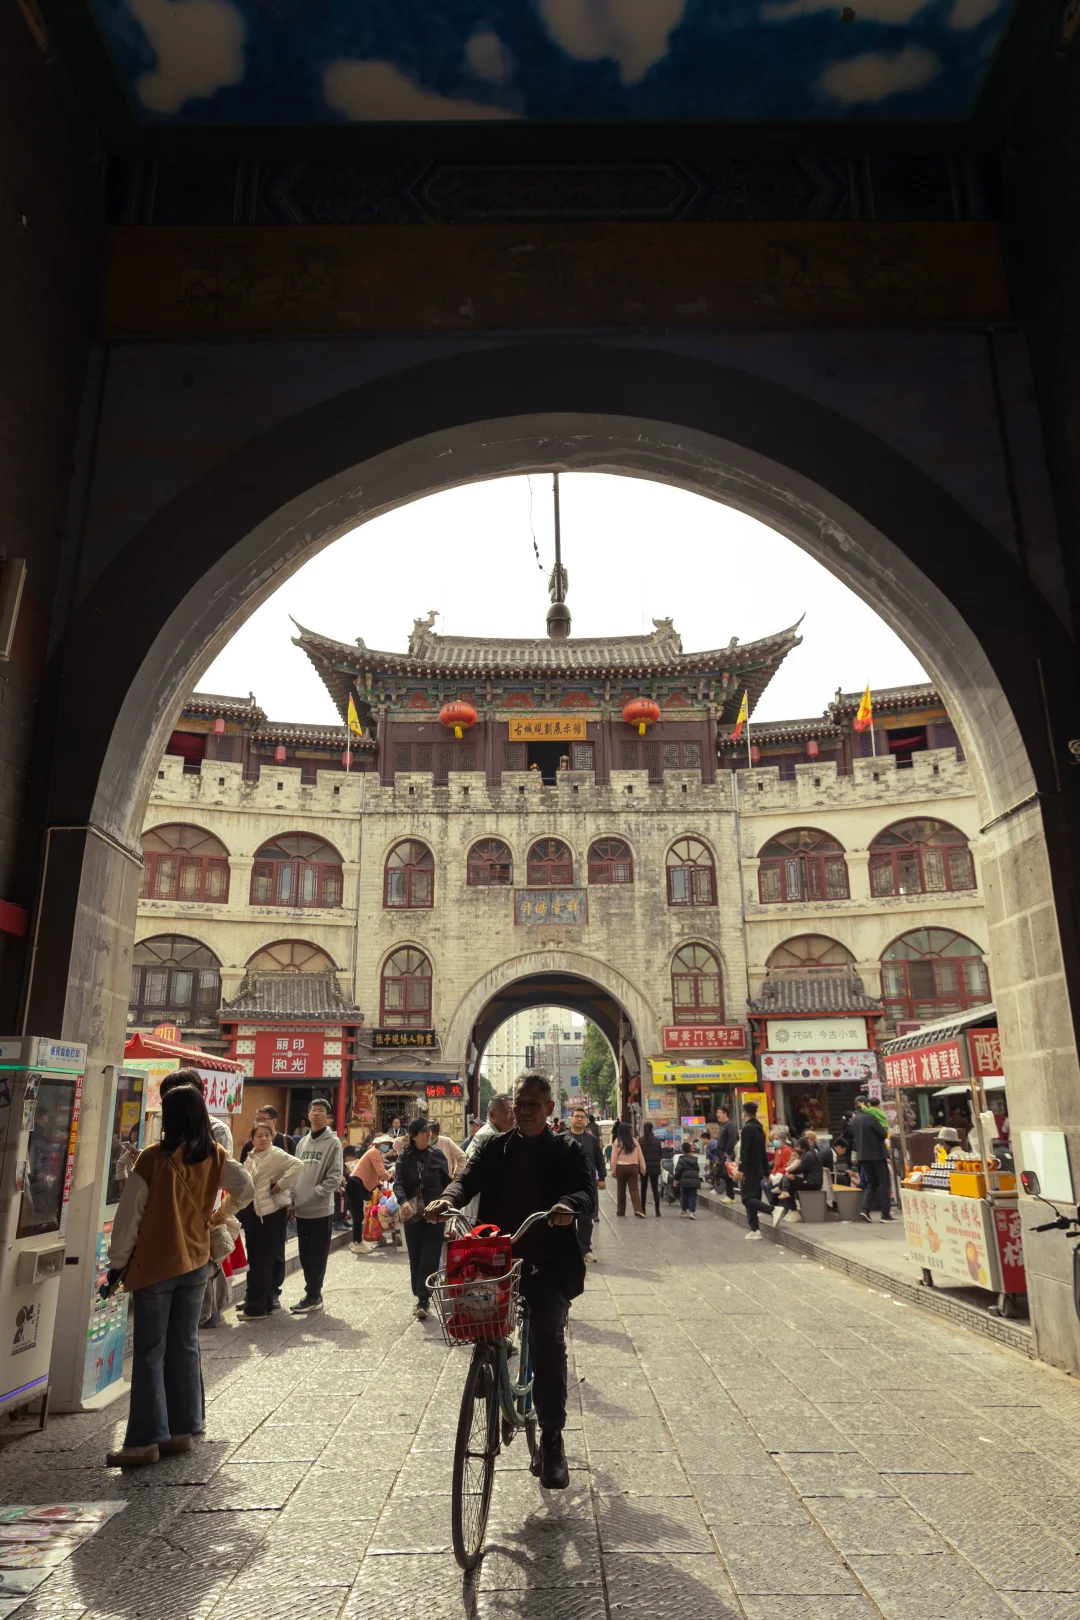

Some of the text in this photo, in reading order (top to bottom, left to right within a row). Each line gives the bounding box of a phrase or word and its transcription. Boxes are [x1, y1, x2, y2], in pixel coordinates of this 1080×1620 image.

[276, 1037, 305, 1051] 丽印
[274, 1058, 304, 1071] 和光
[920, 1048, 961, 1081] 冰糖雪梨
